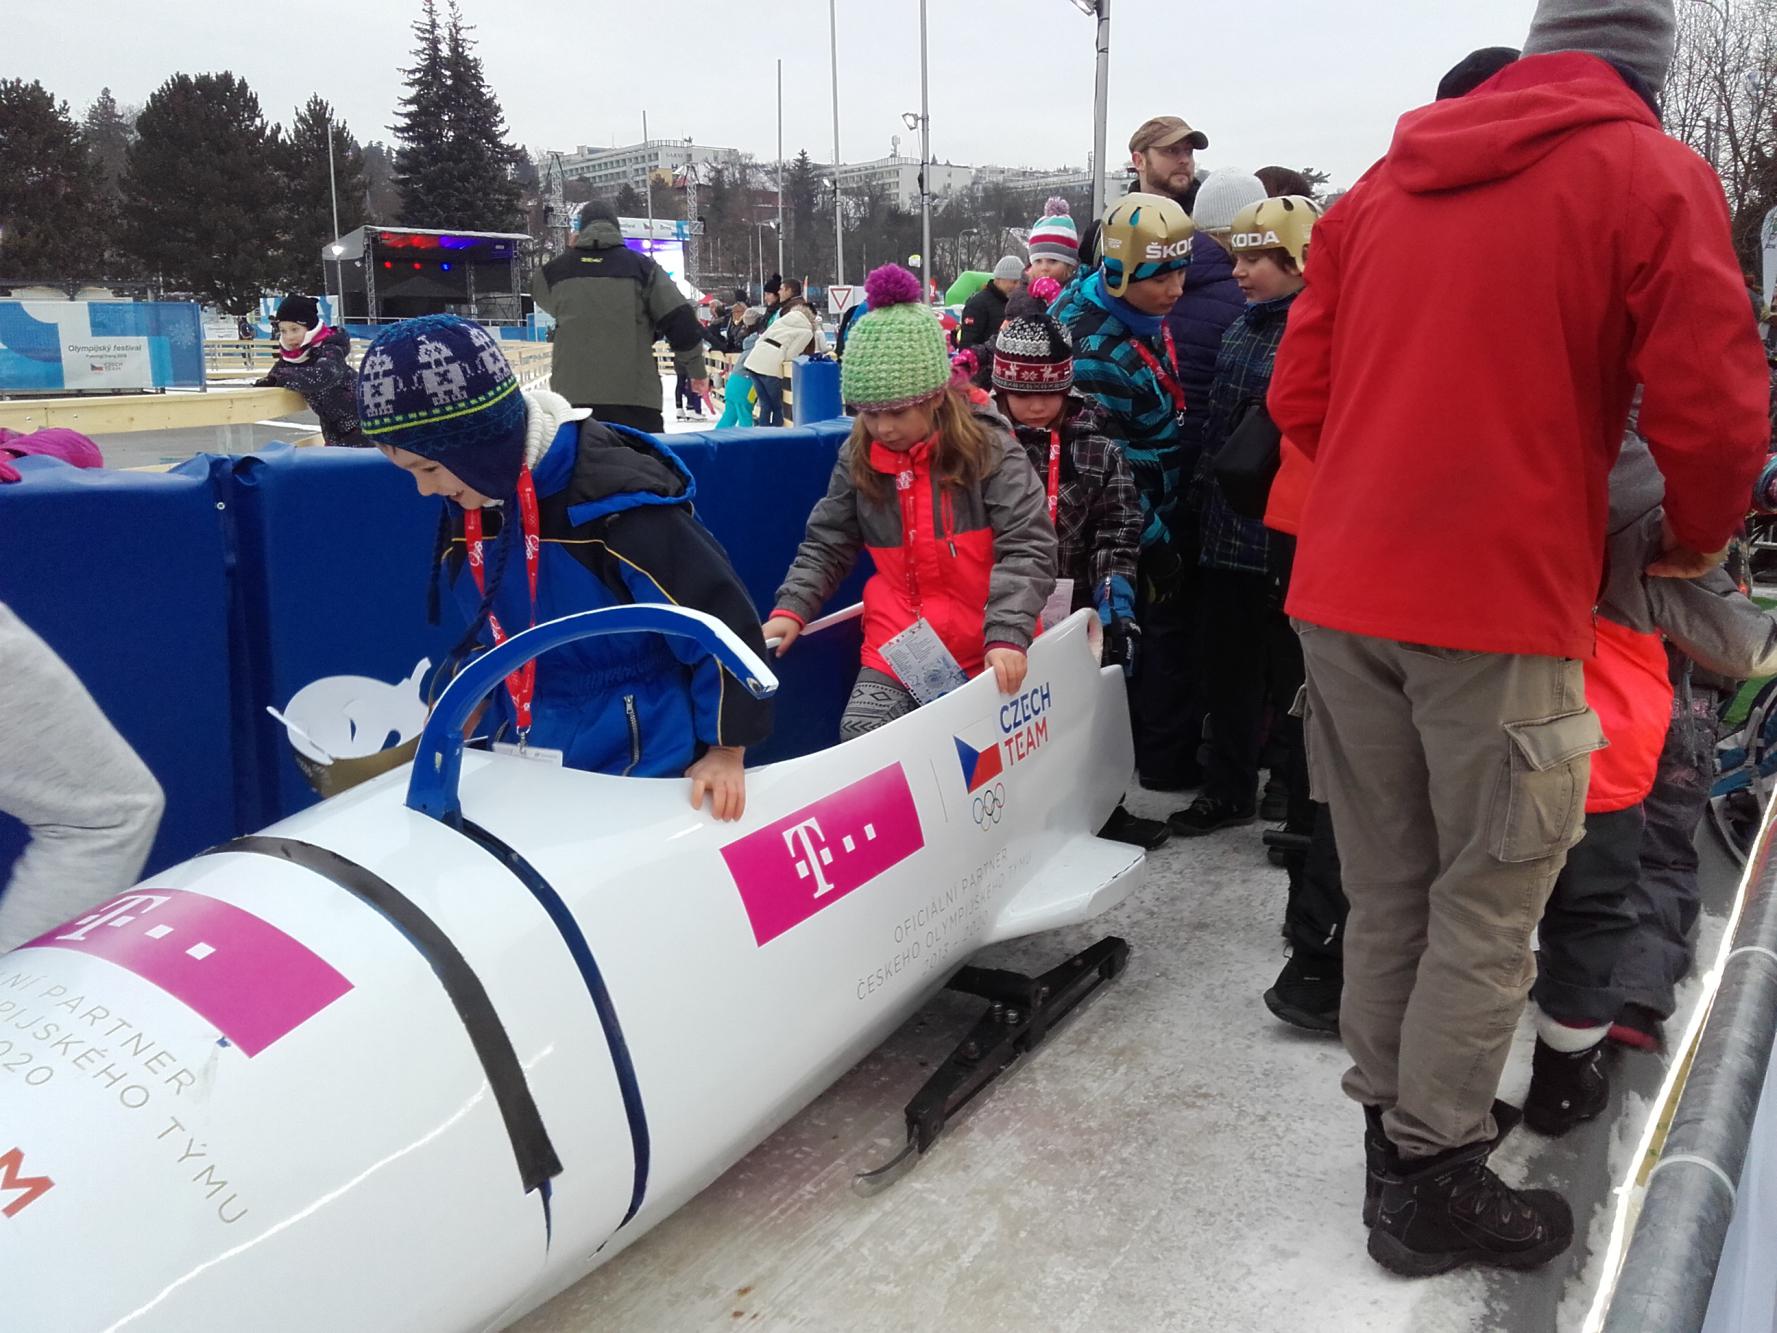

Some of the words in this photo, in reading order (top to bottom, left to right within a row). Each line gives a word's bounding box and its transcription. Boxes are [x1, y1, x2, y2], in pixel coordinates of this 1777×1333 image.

[113, 344, 142, 352] festival
[1000, 682, 1051, 734] CZECH
[1004, 716, 1048, 766] TEAM
[961, 847, 1008, 909] PARTNER
[47, 983, 197, 1095] PARTNER
[157, 1116, 248, 1224] TÝMU
